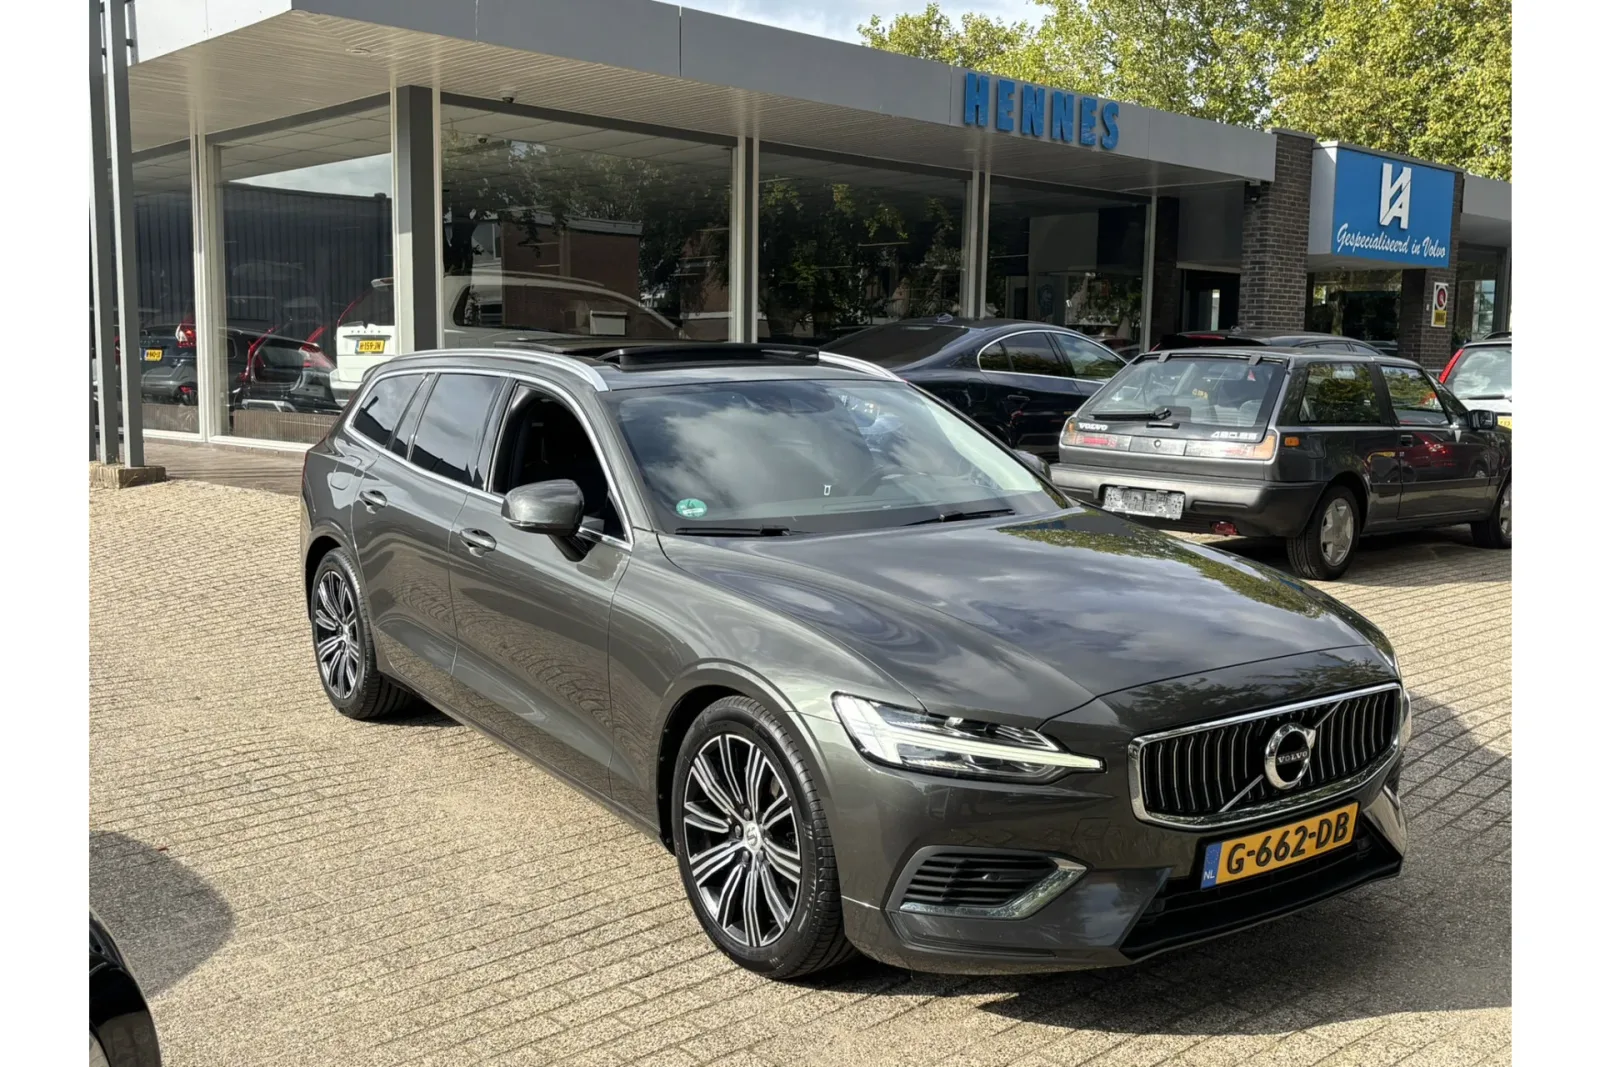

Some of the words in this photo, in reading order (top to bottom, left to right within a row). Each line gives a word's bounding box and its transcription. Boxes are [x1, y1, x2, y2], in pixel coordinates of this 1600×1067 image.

[964, 73, 1119, 150] HENNES
[1337, 223, 1409, 254] Gespecialiseerd
[1411, 239, 1420, 254] in
[1422, 236, 1446, 258] Volvo
[1078, 422, 1109, 431] VOLVO
[1277, 751, 1308, 764] VOLVO
[1227, 812, 1349, 874] G-662-DB
[1203, 869, 1216, 880] NL
